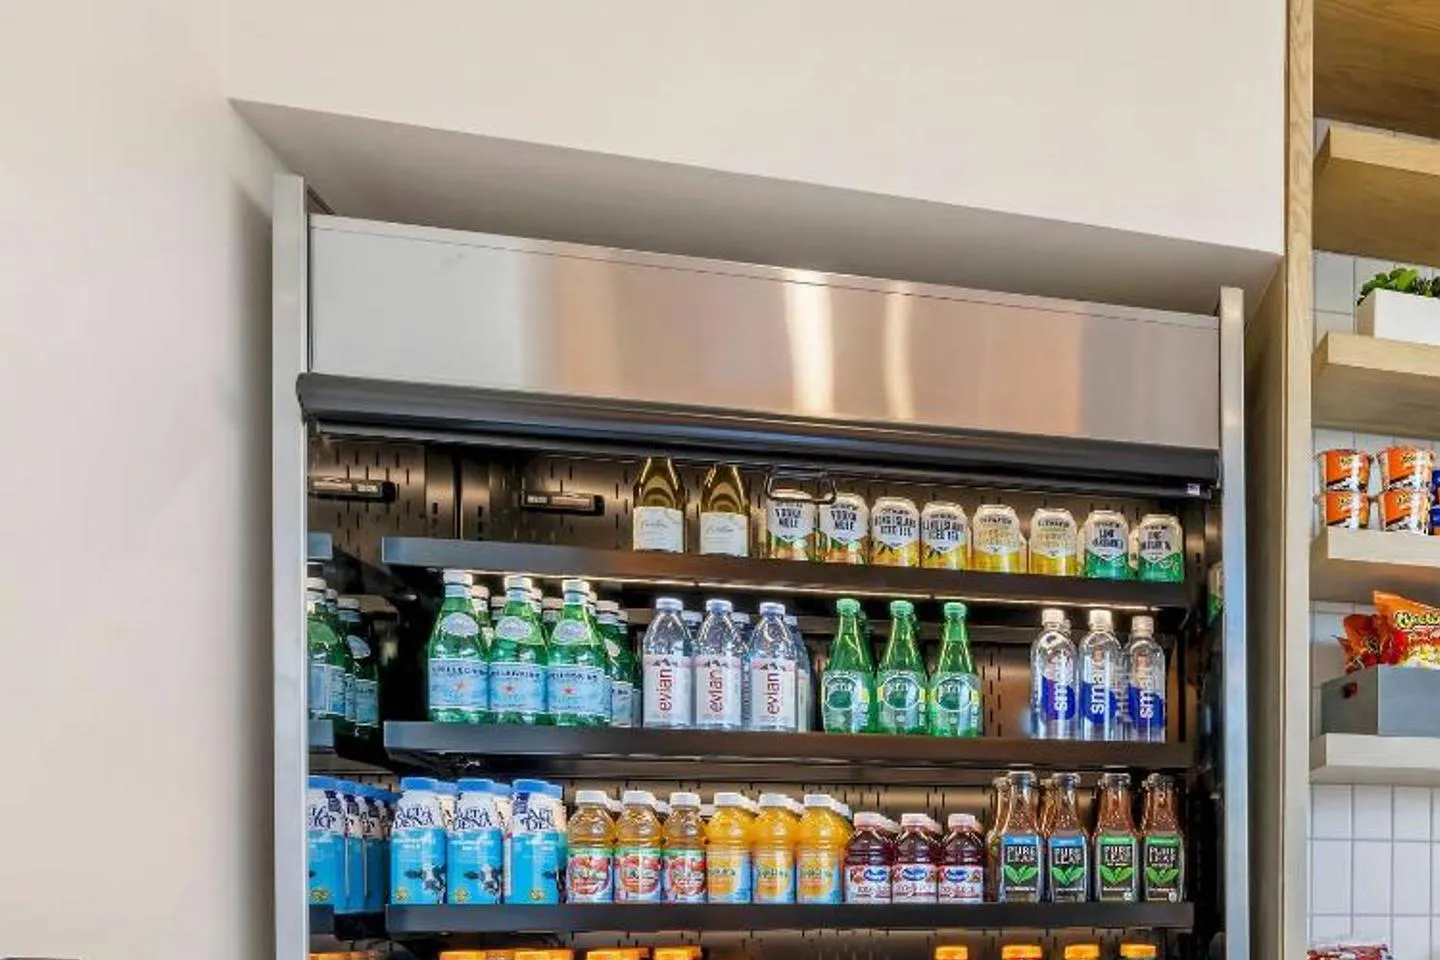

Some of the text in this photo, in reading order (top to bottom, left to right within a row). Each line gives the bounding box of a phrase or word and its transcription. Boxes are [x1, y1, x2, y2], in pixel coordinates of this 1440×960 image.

[657, 668, 672, 713] evian
[708, 669, 723, 713] evian
[765, 672, 780, 715] evian
